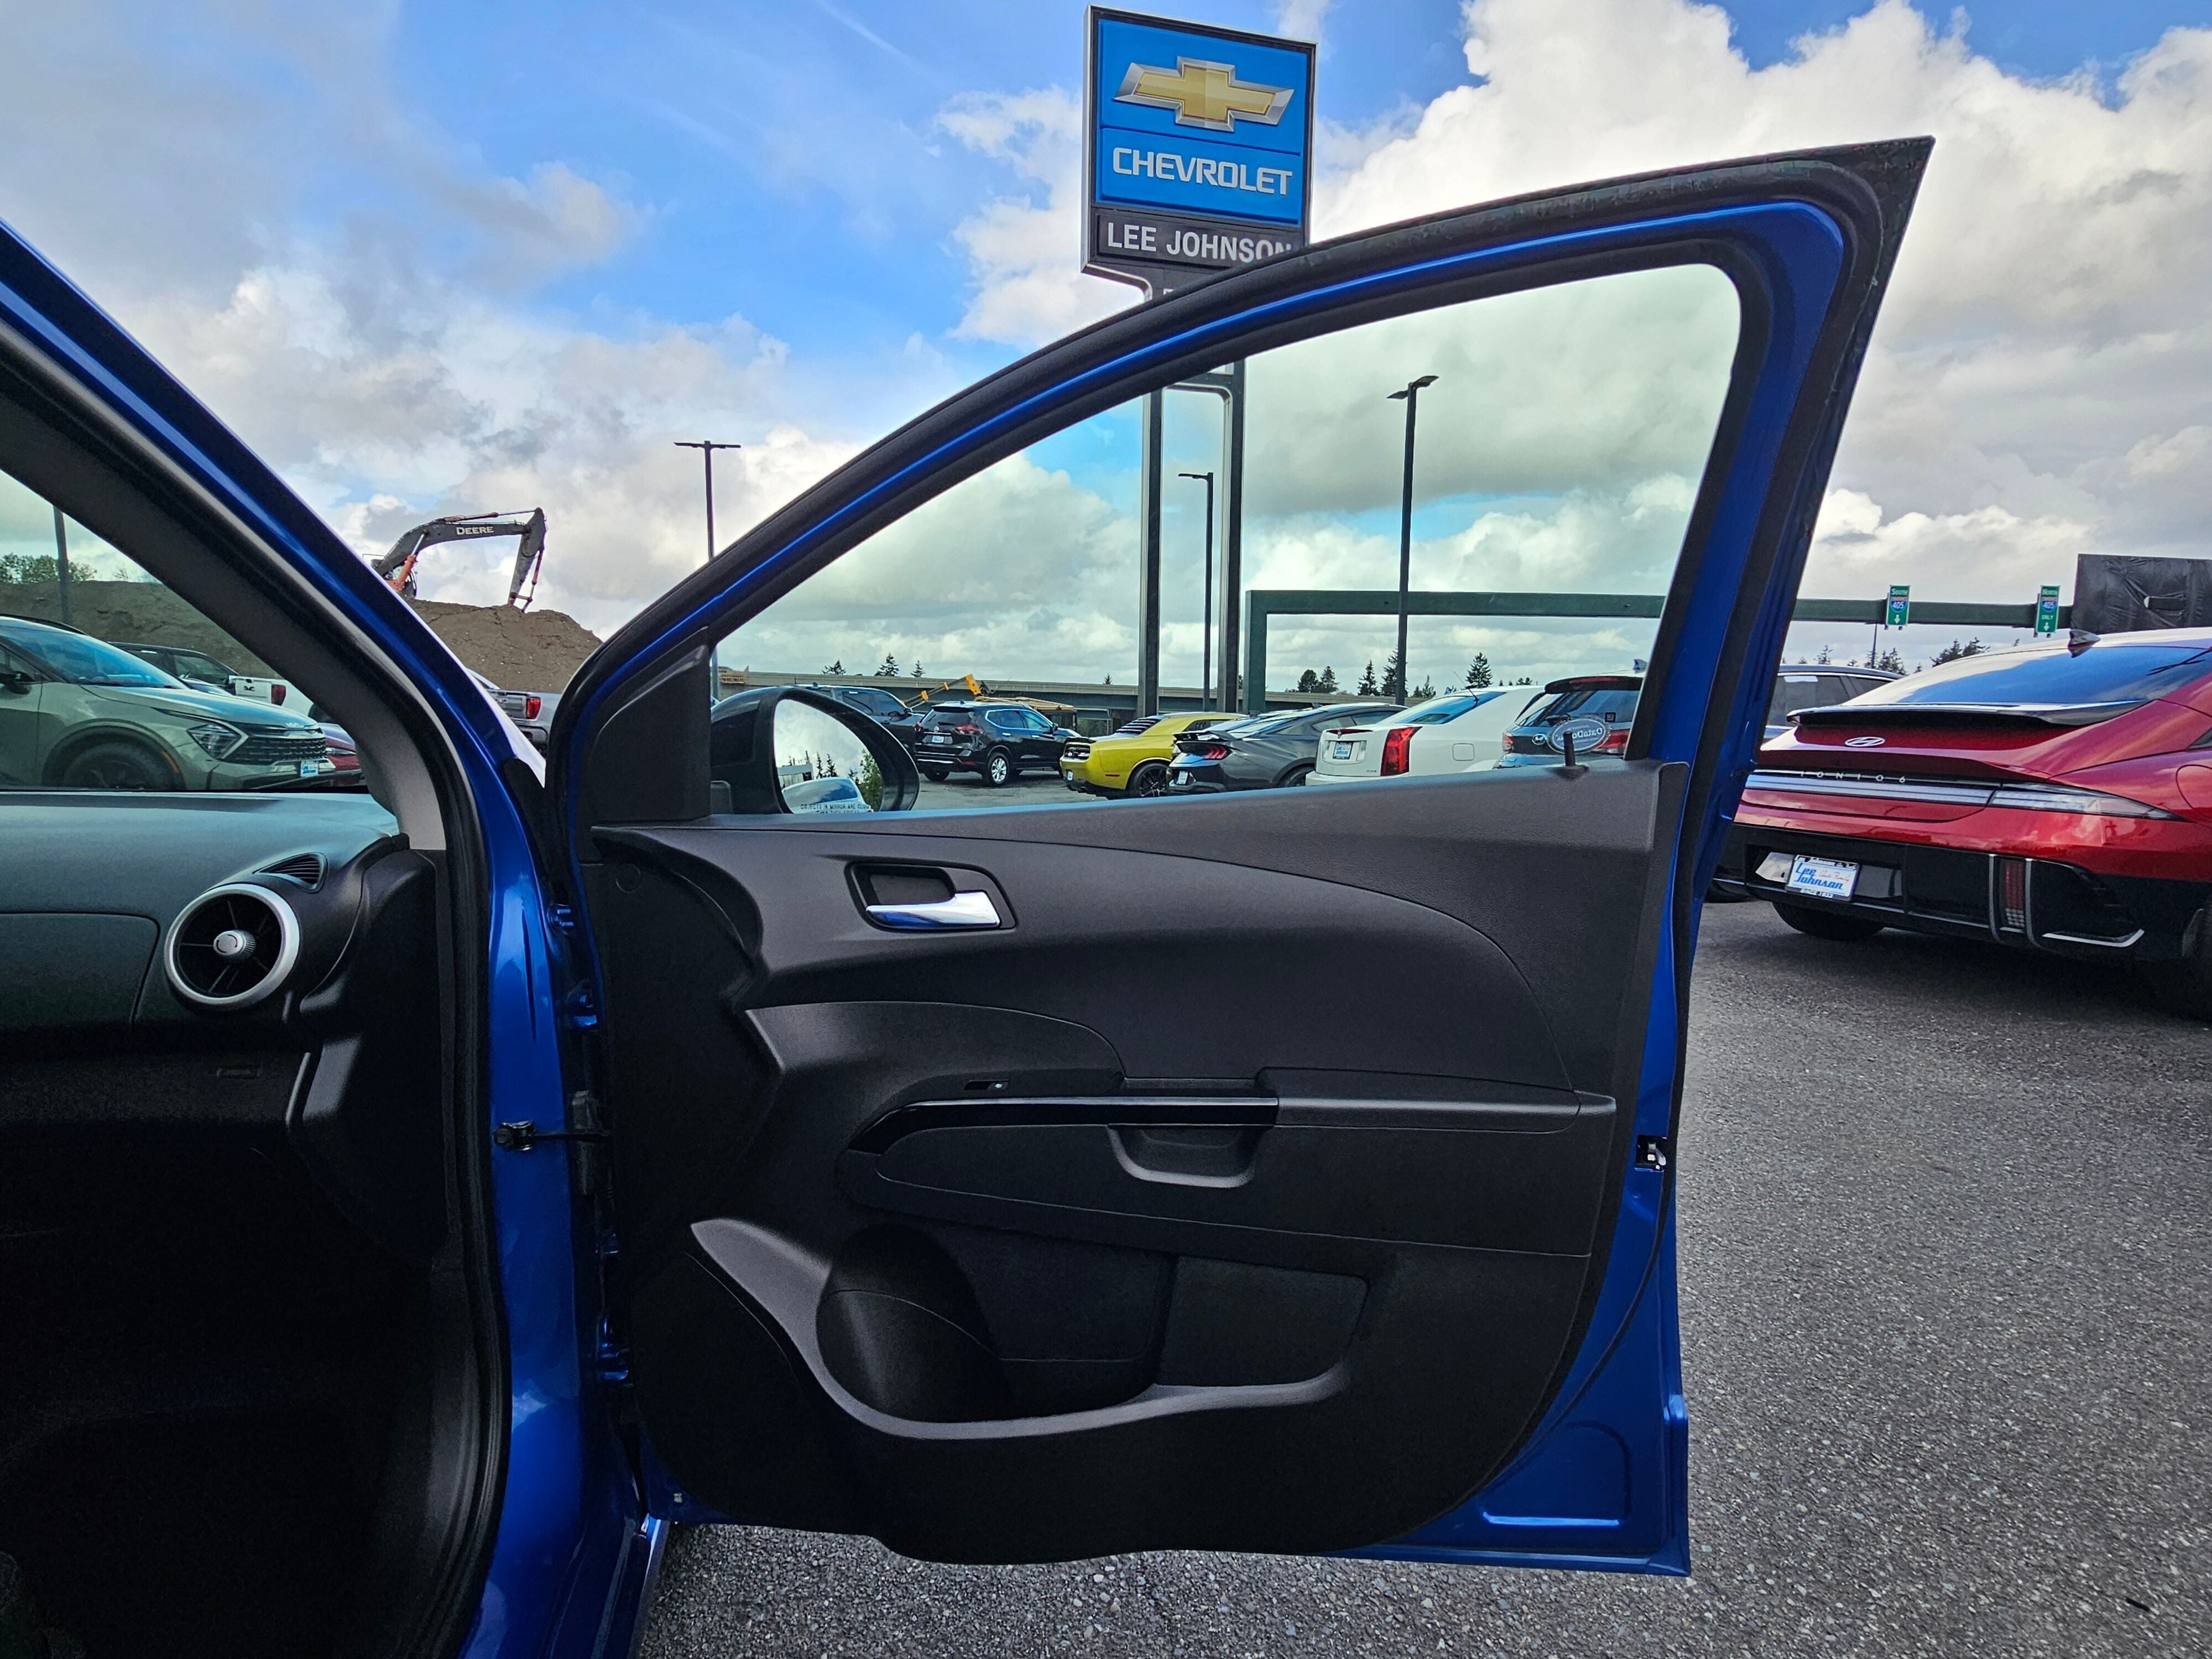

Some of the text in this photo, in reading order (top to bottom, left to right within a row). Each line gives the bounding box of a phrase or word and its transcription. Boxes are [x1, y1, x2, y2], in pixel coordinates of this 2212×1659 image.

[1113, 147, 1293, 195] CHEVROLET
[1108, 222, 1156, 252] LEE
[456, 526, 494, 535] DEERE
[1795, 863, 1817, 875] Lee
[1793, 871, 1844, 890] Johnson
